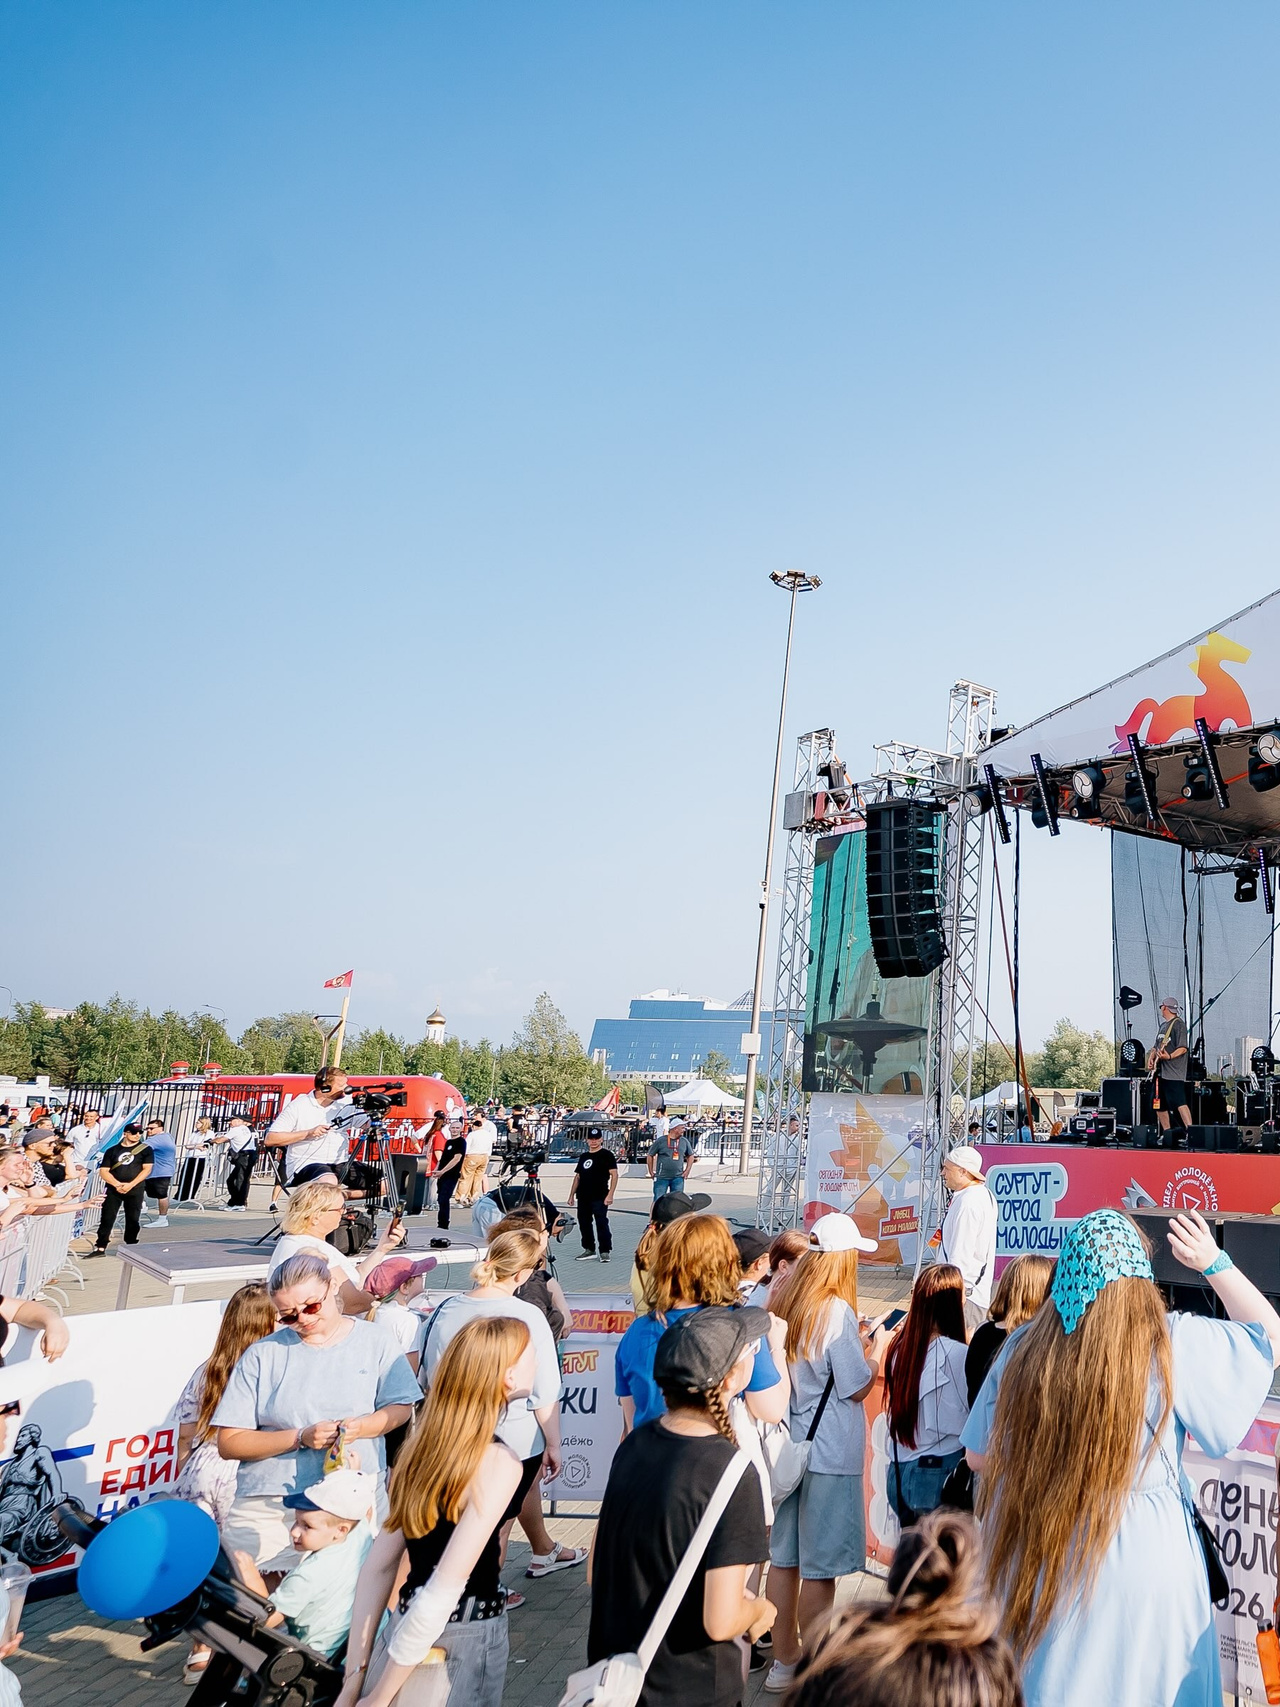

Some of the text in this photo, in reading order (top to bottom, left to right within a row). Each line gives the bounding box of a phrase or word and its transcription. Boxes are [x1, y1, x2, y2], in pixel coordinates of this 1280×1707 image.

[994, 1171, 1052, 1195] СУРГУТ
[1163, 1181, 1174, 1208] ТДЕЛ
[1174, 1166, 1219, 1212] МОЛОДЁЖНО
[106, 1429, 175, 1463] ГОД
